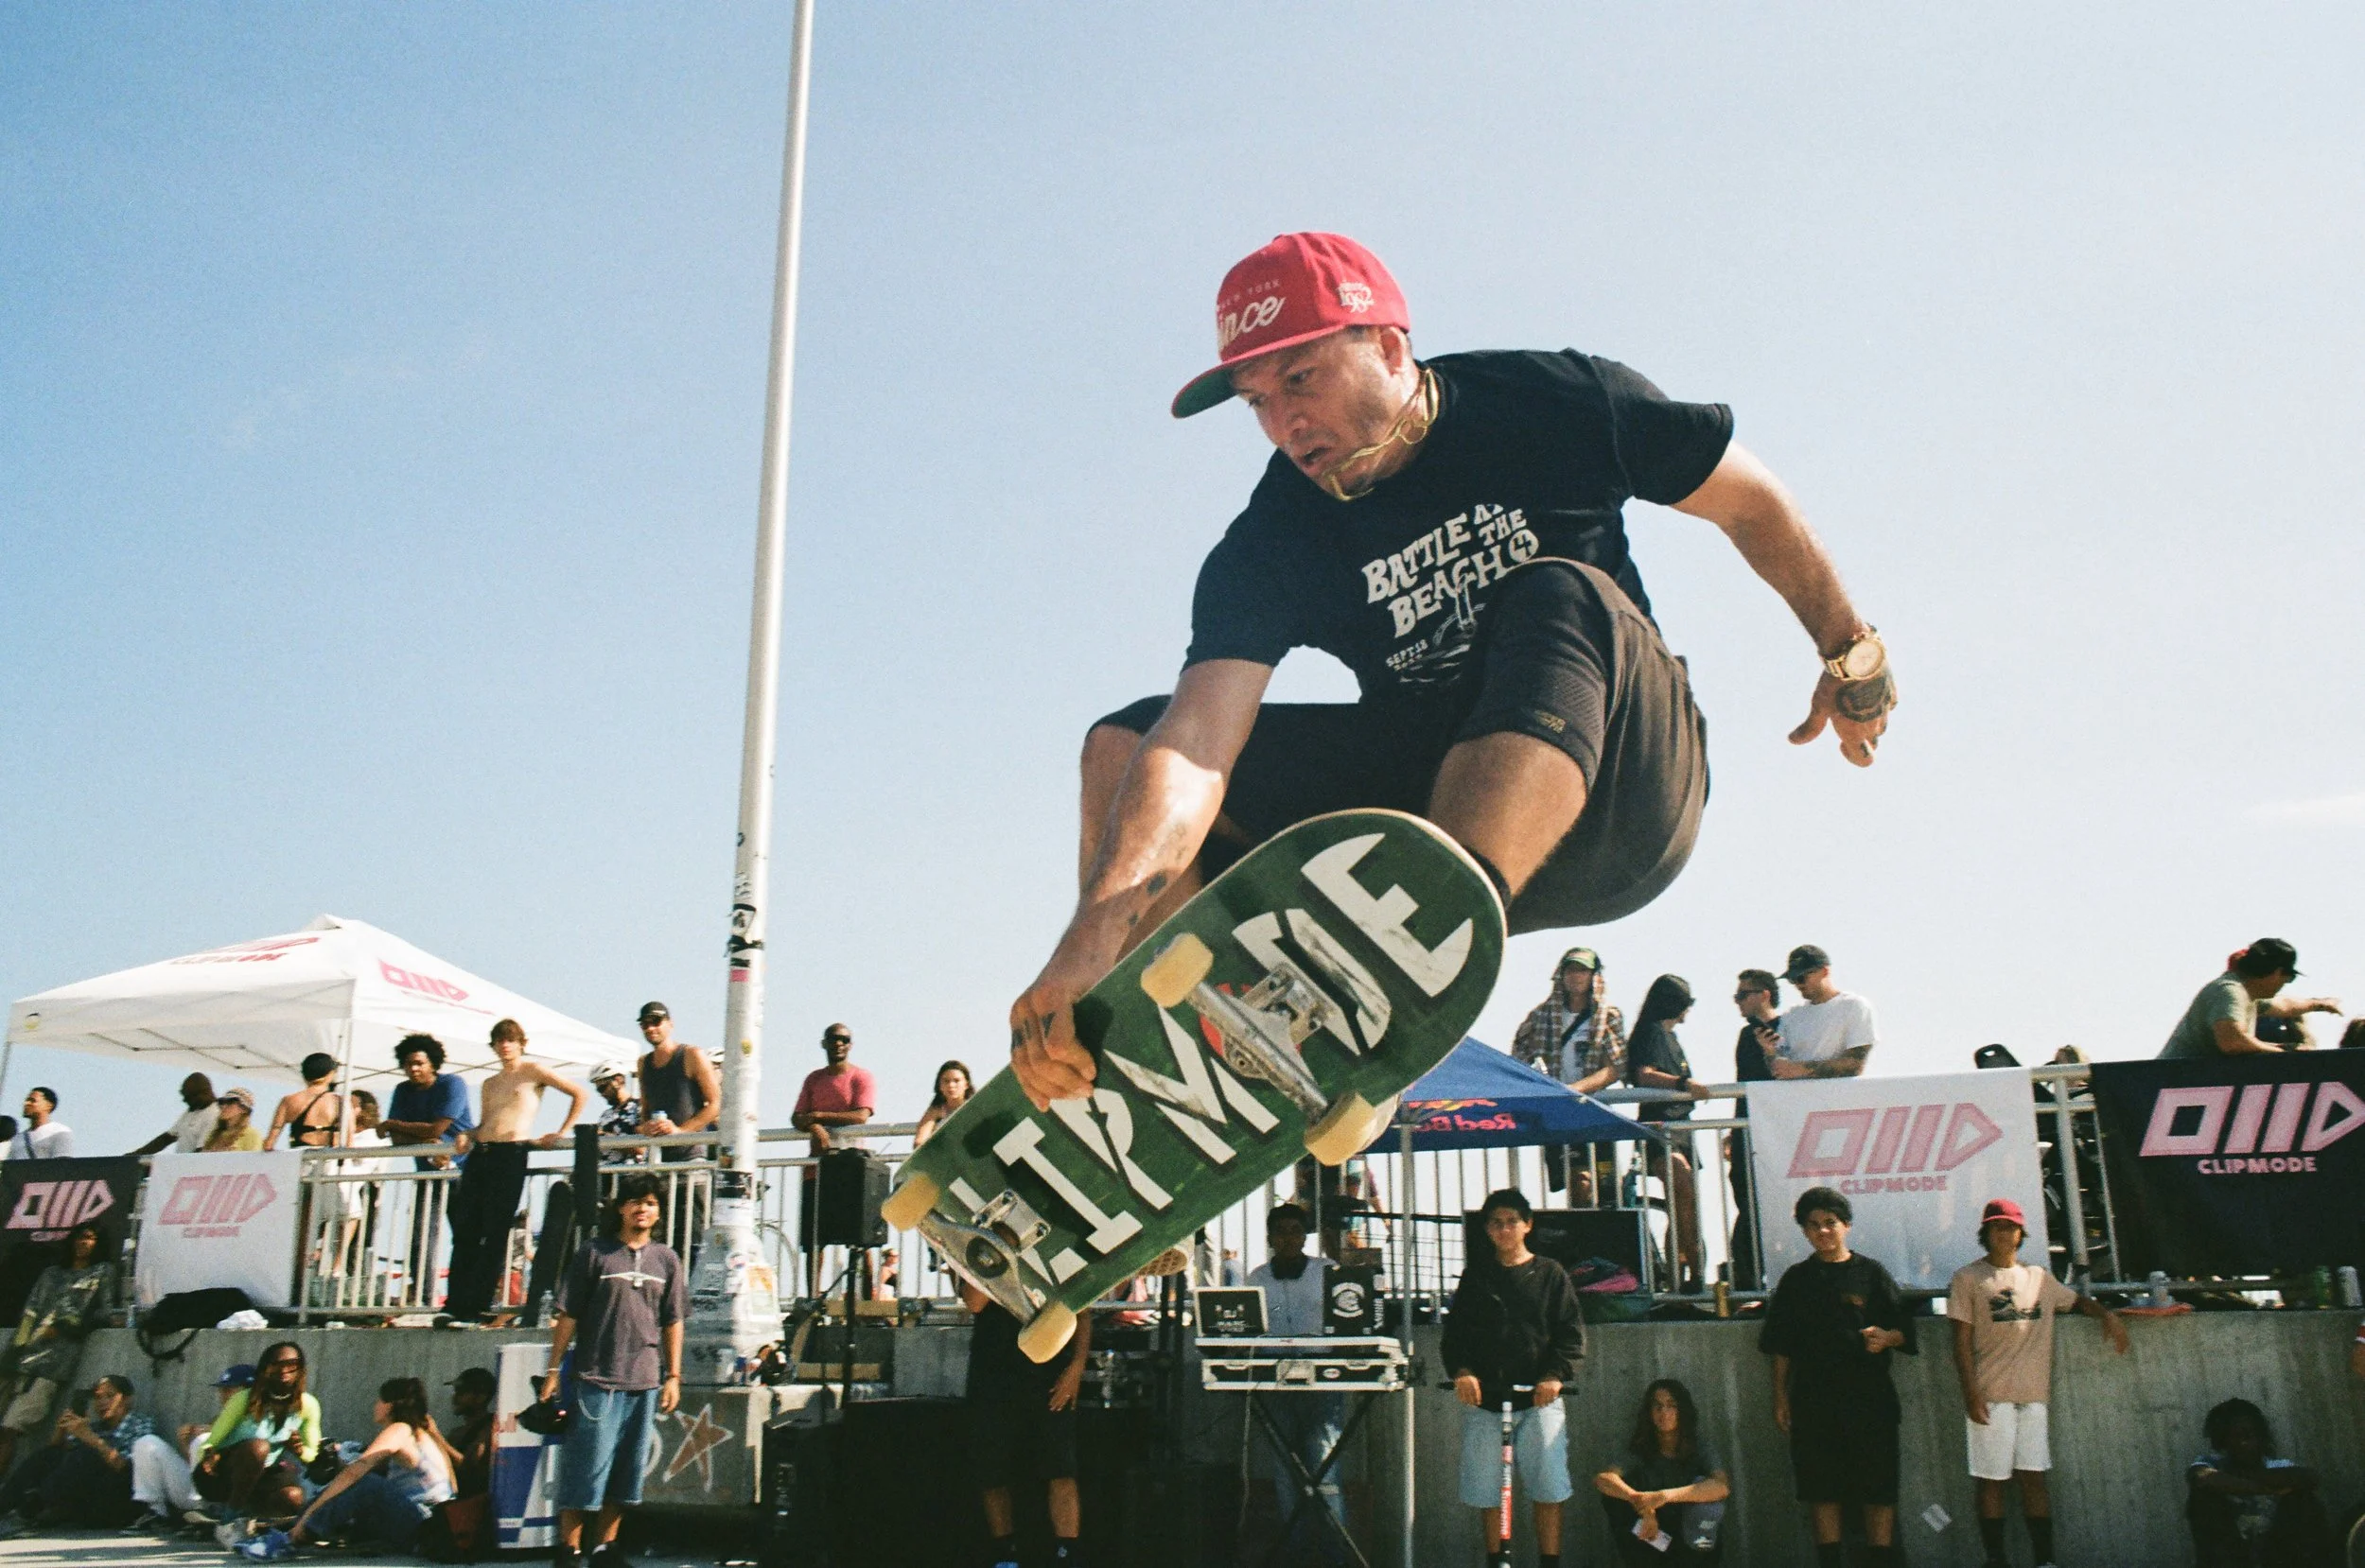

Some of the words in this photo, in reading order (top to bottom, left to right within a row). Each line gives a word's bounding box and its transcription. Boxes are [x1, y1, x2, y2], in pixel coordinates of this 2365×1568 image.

[1479, 509, 1527, 546] THE
[1361, 513, 1472, 604] BATTLE
[1387, 545, 1507, 638] BEACH
[1839, 1175, 1948, 1194] CLIPMODE
[2197, 1157, 2318, 1175] CLIPMODE
